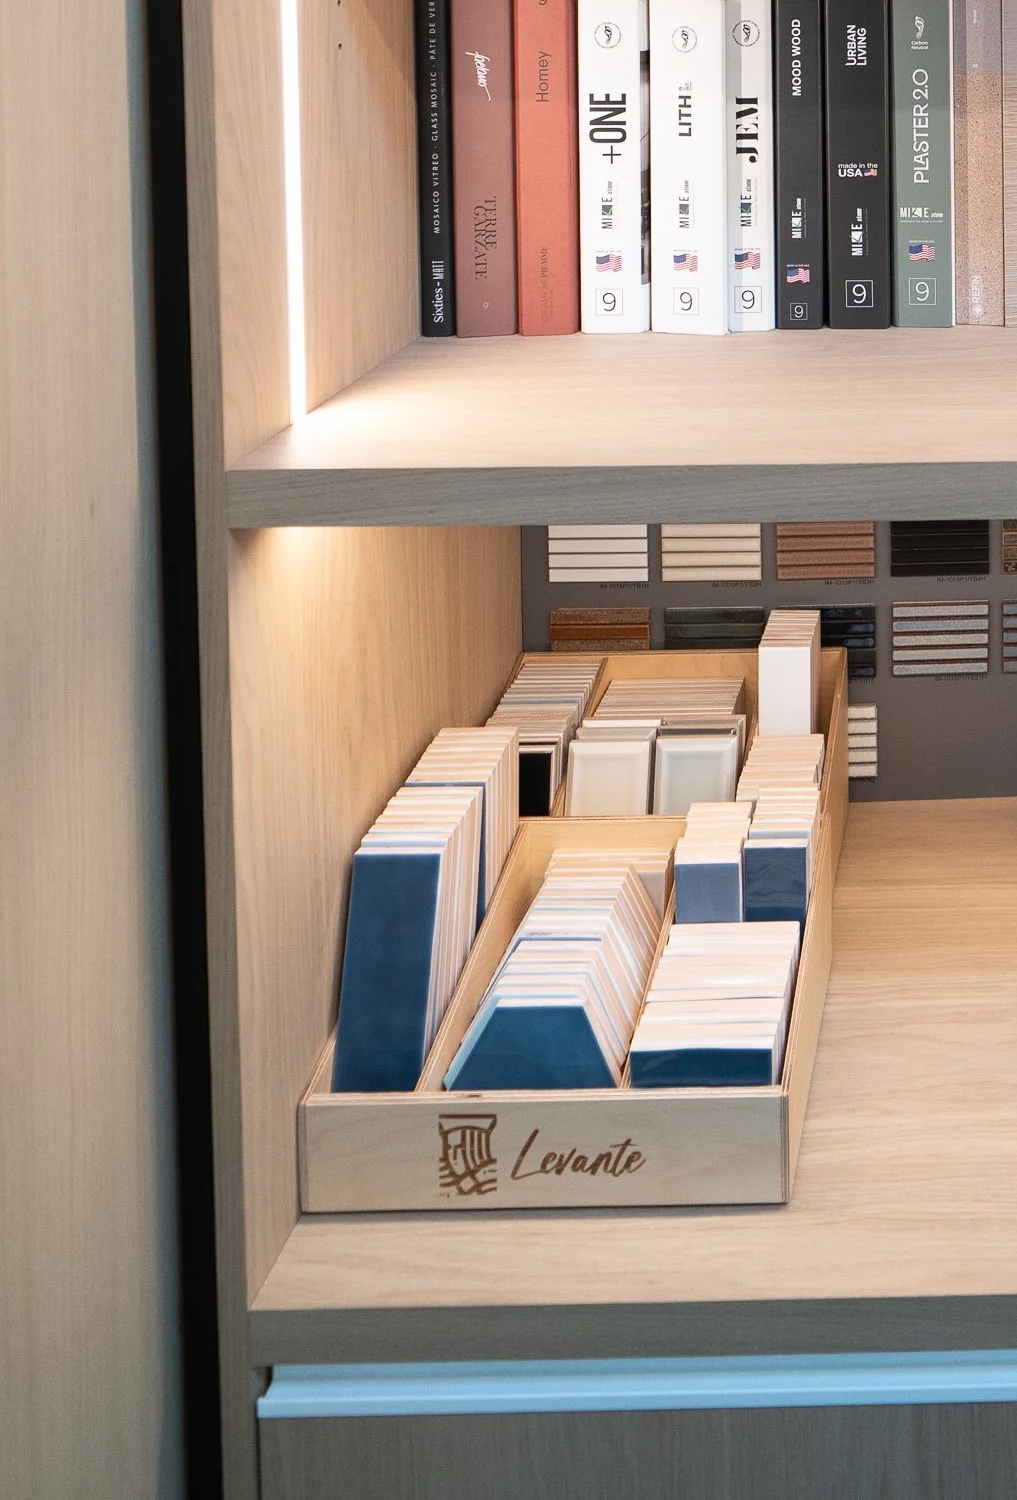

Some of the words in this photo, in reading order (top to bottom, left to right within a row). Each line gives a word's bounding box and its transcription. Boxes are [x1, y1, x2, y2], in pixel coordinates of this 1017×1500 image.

[429, 22, 435, 33] DE
[792, 19, 801, 56] WOOD
[846, 25, 856, 66] URBAN
[857, 27, 867, 66] LIVING
[536, 51, 552, 102] Homey
[792, 60, 801, 96] MOOD
[913, 69, 928, 99] 2.0
[589, 93, 627, 164] +ONE
[679, 95, 691, 137] LITH
[736, 97, 759, 164] JEM
[913, 104, 929, 184] PLASTER
[838, 169, 863, 177] USA
[485, 196, 496, 250] TERRE
[474, 205, 487, 280] GARZATE
[433, 261, 444, 280] MATT
[434, 288, 443, 322] Sixties
[603, 293, 616, 312] 9
[679, 292, 693, 311] 9
[741, 290, 755, 309] 9
[853, 284, 867, 303] 9
[915, 282, 930, 301] 9
[972, 276, 980, 302] REFIN
[795, 306, 803, 318] 9
[511, 1129, 647, 1181] Levante
